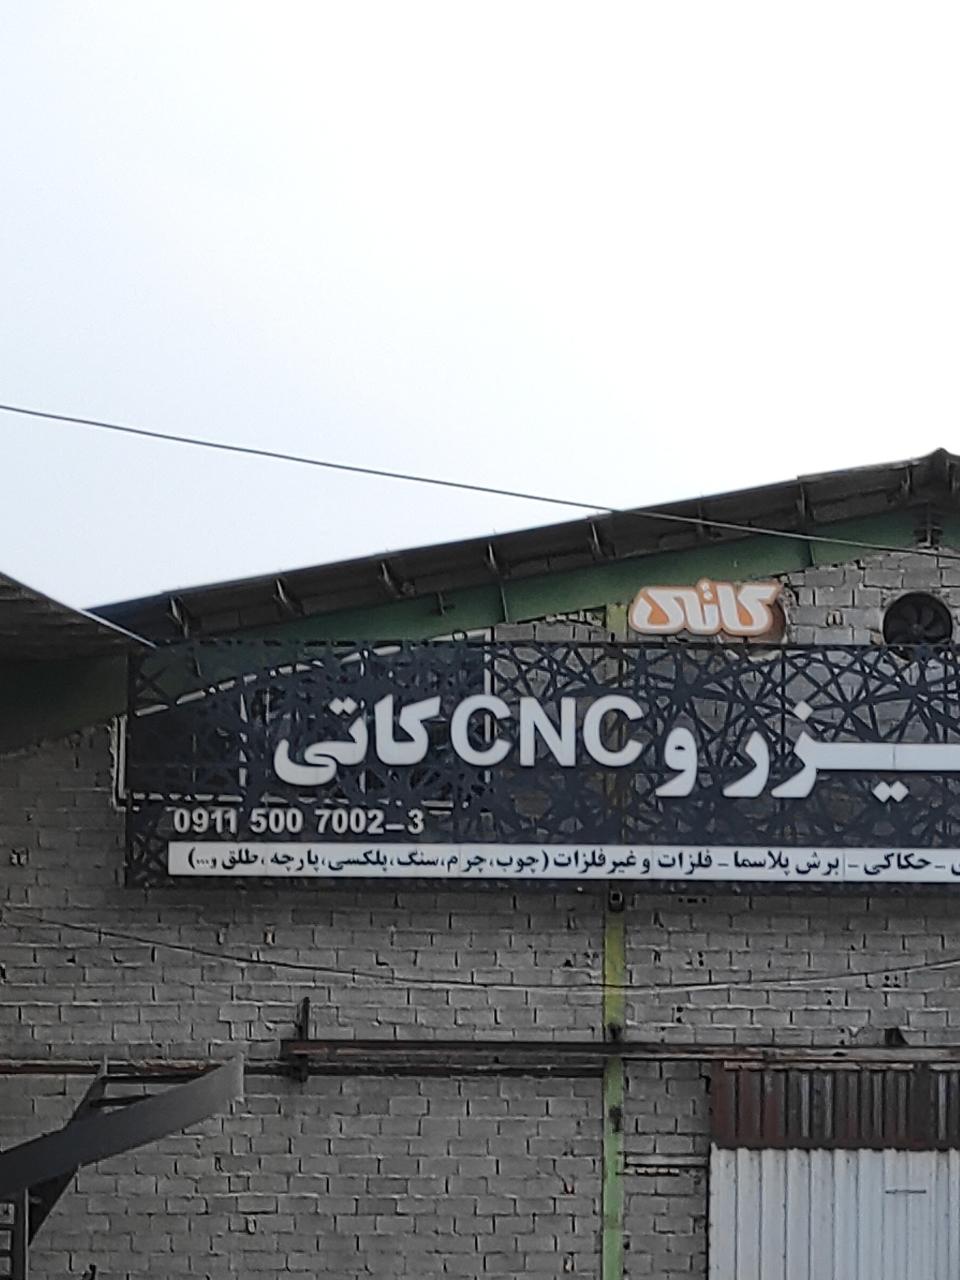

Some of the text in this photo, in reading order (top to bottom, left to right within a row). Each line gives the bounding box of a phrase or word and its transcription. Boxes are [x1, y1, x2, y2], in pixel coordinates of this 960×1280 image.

[273, 695, 441, 787] کاتی
[450, 694, 644, 767] CNC
[654, 727, 697, 797] و
[173, 807, 238, 833] 0911
[250, 807, 304, 833] 500
[657, 850, 713, 876] فلزات
[733, 850, 790, 876] پلاسما
[795, 852, 840, 876] برش
[863, 852, 932, 876] حکاکی
